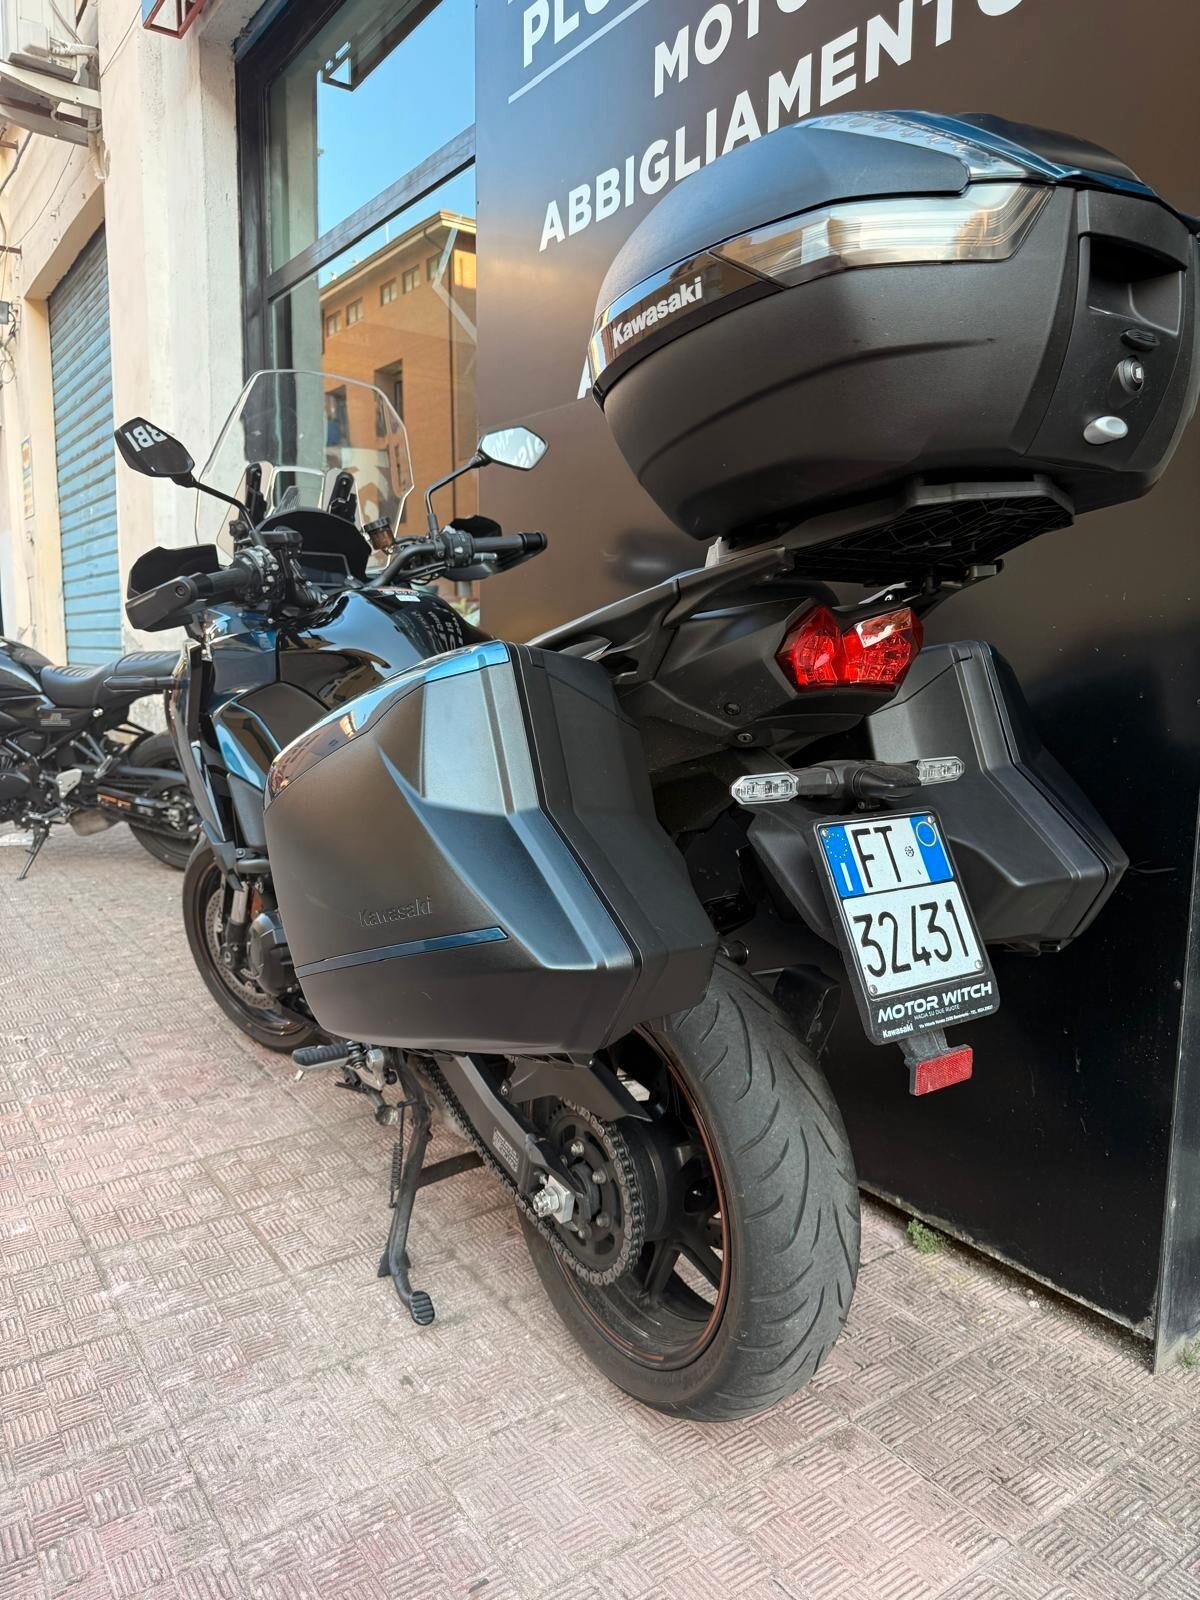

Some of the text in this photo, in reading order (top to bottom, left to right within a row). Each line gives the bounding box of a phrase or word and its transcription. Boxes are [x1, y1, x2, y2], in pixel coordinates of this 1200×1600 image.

[523, 0, 612, 68] PL
[654, 0, 808, 98] MOT
[539, 0, 1023, 252] ABBIGLIAMENT
[612, 277, 703, 349] Kawasaki
[851, 825, 902, 888] FT
[359, 896, 432, 927] Kawasaki
[852, 899, 969, 978] 32431
[878, 995, 938, 1022] MOTOR
[942, 982, 992, 1005] WITCH
[883, 1023, 913, 1038] Kawasaki
